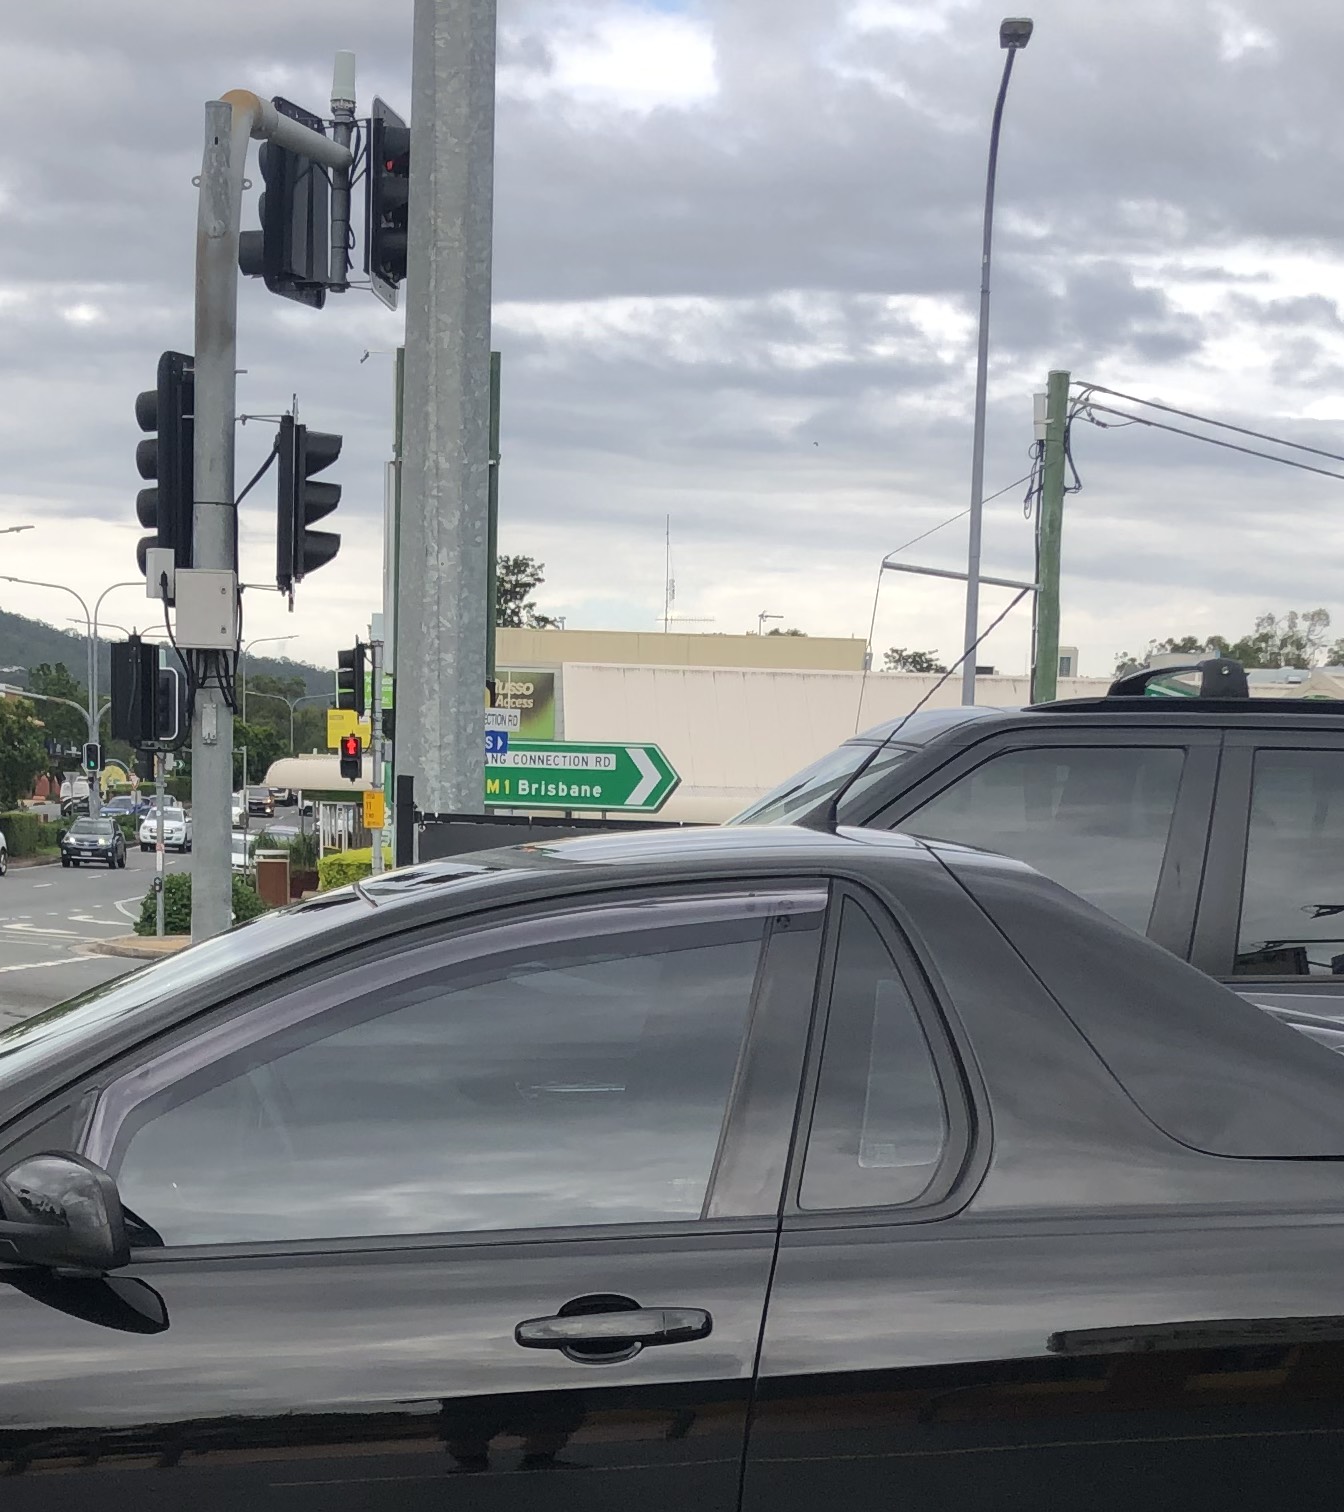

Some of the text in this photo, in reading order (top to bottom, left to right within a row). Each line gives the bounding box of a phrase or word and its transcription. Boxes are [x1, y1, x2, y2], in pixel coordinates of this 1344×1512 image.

[495, 697, 534, 709] Access
[512, 753, 590, 767] CONNECTION
[594, 756, 611, 768] RD
[518, 779, 603, 798] Brisbane
